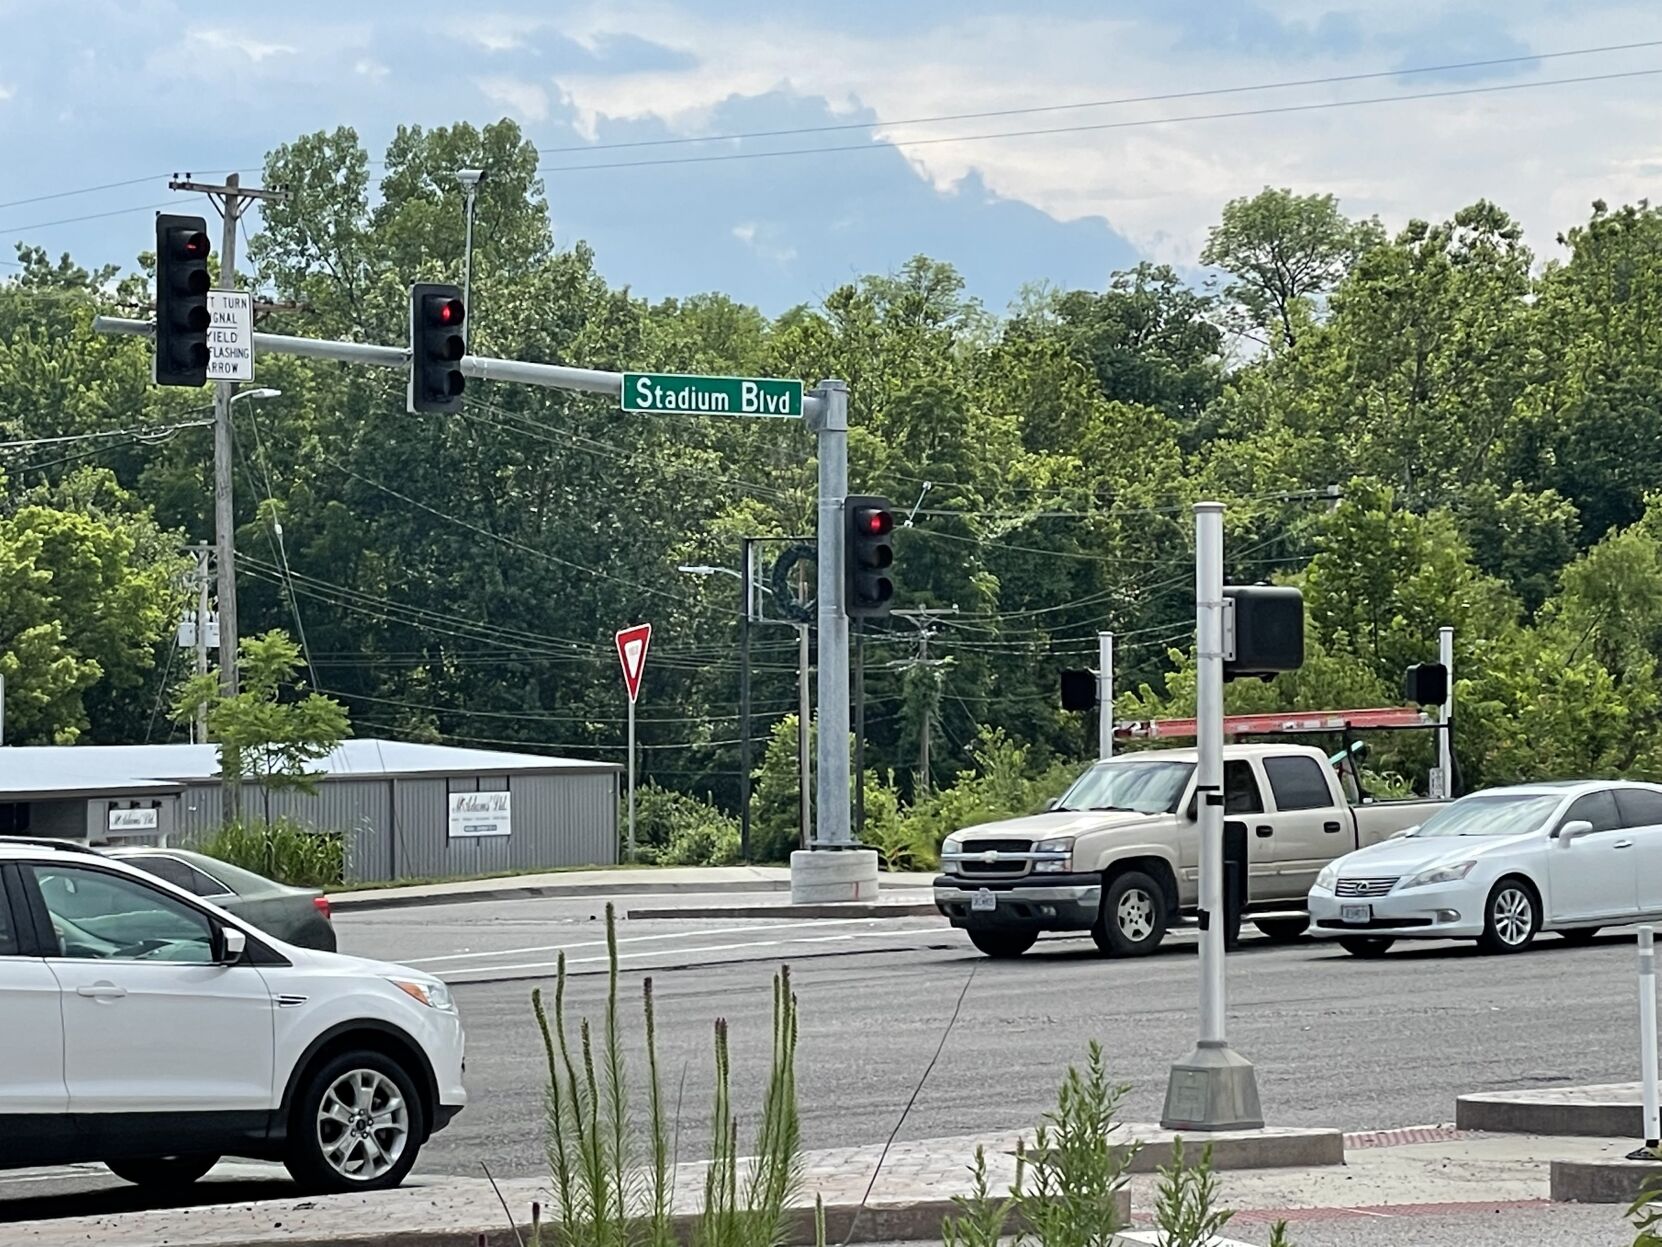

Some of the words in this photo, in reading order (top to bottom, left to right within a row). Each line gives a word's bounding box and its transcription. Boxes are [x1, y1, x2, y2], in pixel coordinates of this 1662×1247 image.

[224, 297, 247, 309] TURN
[209, 312, 238, 324] GNAL
[207, 332, 238, 343] YIELD
[636, 377, 729, 411] Stadium
[741, 381, 790, 414] Blvd
